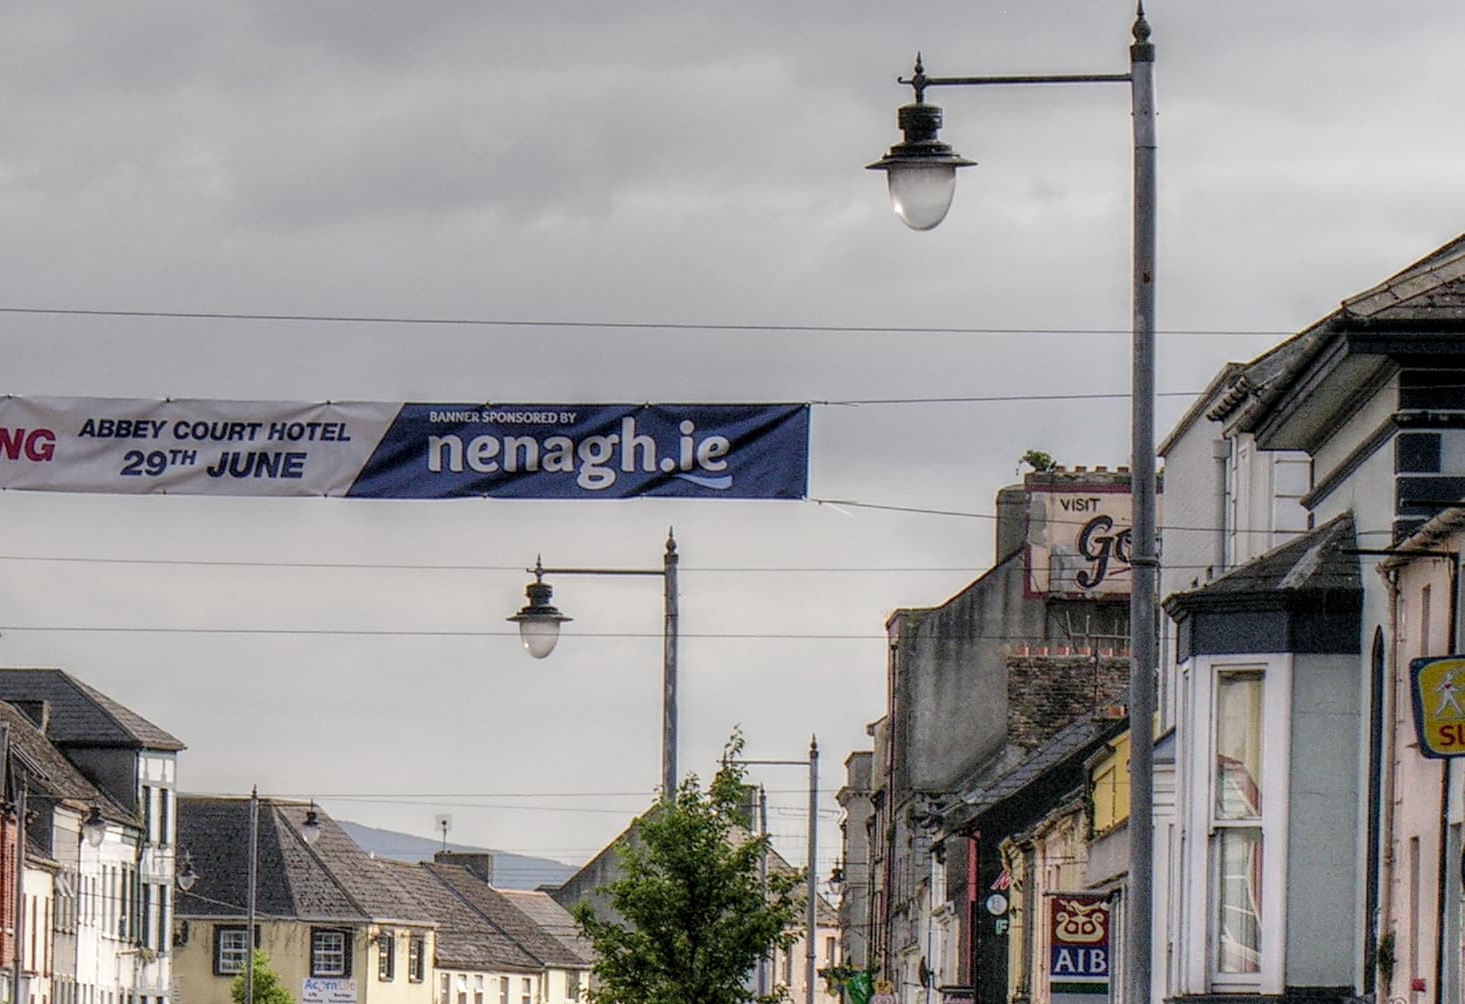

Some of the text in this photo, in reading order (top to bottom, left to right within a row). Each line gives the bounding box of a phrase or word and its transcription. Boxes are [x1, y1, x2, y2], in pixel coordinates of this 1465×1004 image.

[430, 411, 576, 424] BANNER SPONSORED BY
[79, 419, 351, 442] ABBEY COURT HOTEL
[120, 449, 307, 479] 29TH JUNE
[427, 416, 731, 490] nenagh.ie
[1060, 498, 1101, 512] VISIT
[1053, 948, 1108, 974] AIB
